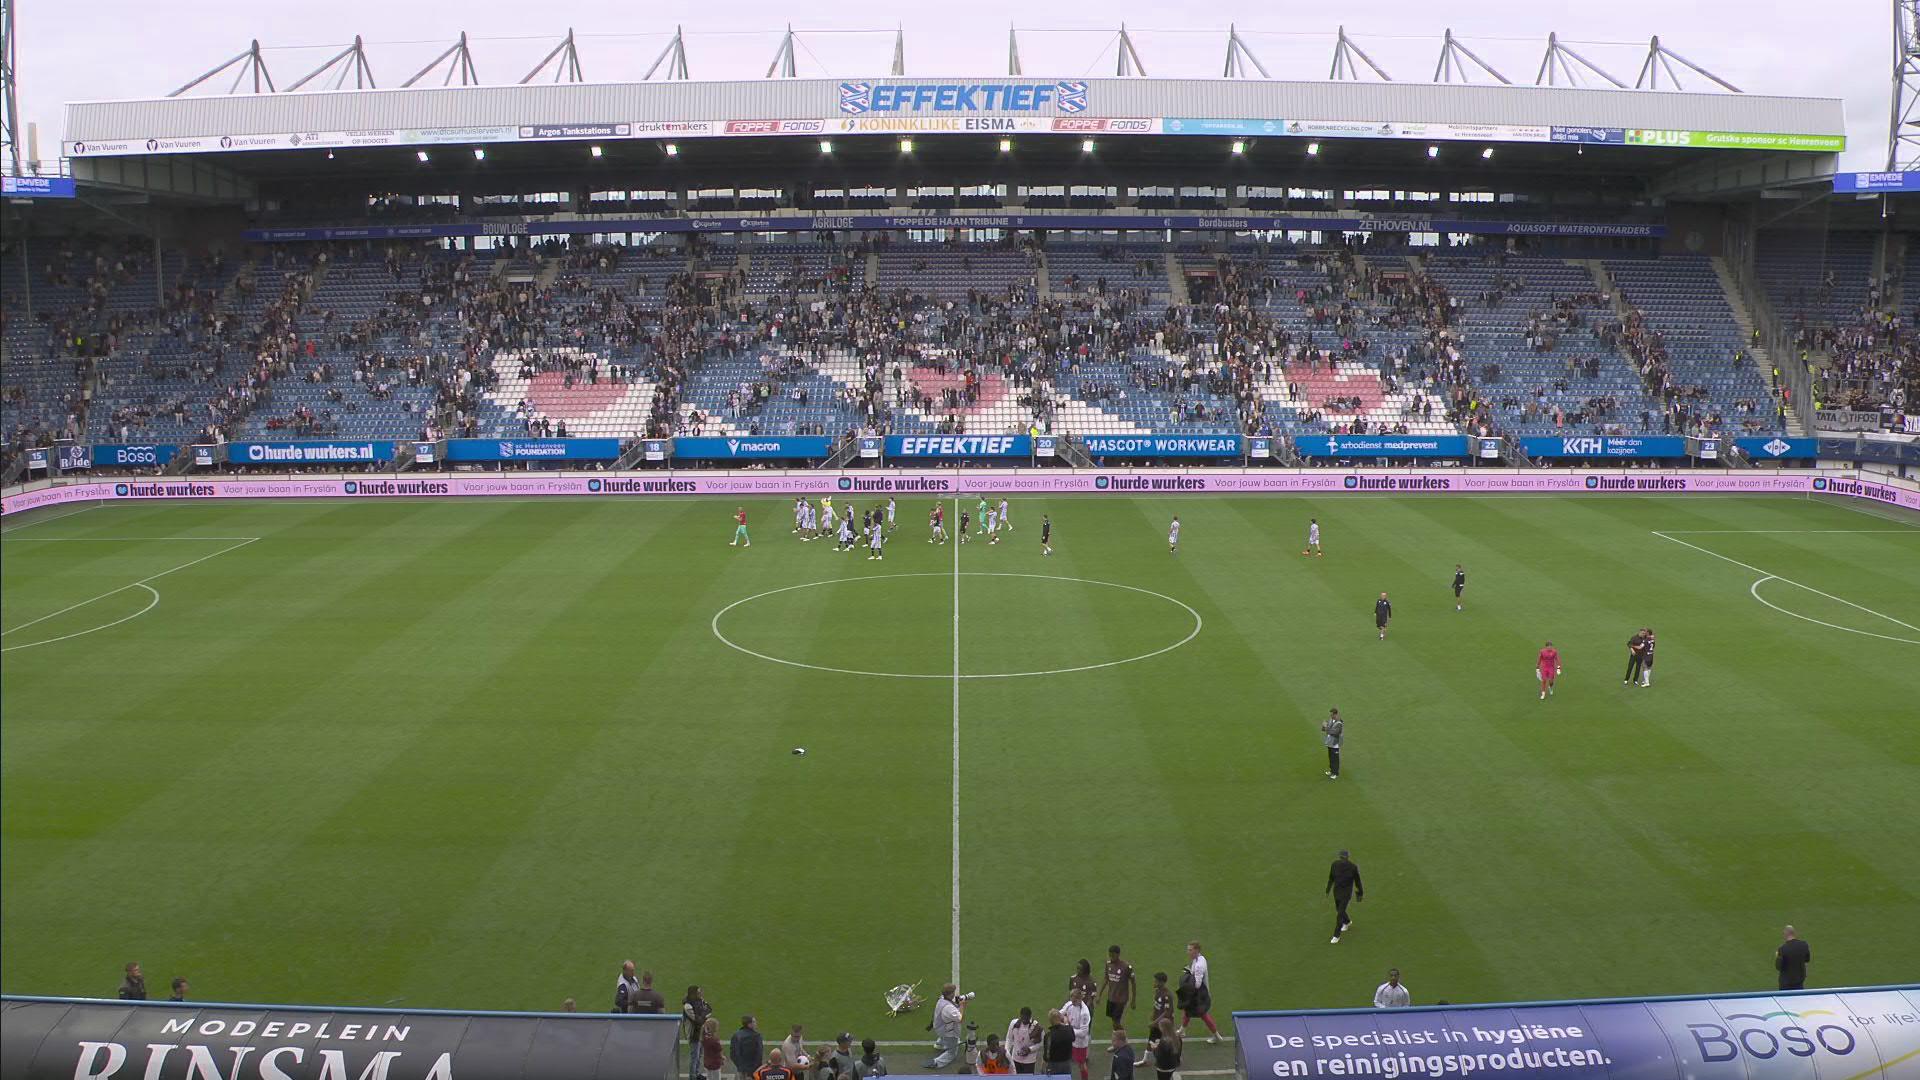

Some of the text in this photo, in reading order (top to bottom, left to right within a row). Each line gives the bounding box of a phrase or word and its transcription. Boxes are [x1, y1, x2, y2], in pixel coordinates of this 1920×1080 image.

[870, 84, 1056, 111] EFFEKTIEF
[638, 122, 708, 132] druktemakers
[733, 122, 820, 132] FOPPE FONDS
[859, 118, 1015, 131] KONINKLIJKE EISMA
[1060, 120, 1148, 130] FOPPE FONDS
[538, 126, 611, 137] Argos Tankstations
[233, 137, 276, 146] Van Vuuren
[1644, 131, 1690, 144] PLUS
[1706, 134, 1740, 144] Grutske
[1742, 136, 1776, 146] sponsor
[1788, 137, 1840, 147] Heerenveen
[86, 143, 128, 152] Van Vuuren
[160, 140, 201, 149] Van Vuuren
[812, 217, 854, 229] AGRILOGE
[894, 218, 924, 226] FOPPE
[925, 218, 937, 226] DE
[969, 217, 1009, 225] TRIBUNE
[1199, 218, 1248, 227] Bordbusters
[1359, 220, 1433, 230] ZETHOVEN.NL
[483, 224, 528, 234] BOUWLOGE
[1506, 224, 1651, 235] AQUASOFT WATERONTHARDERS
[1816, 412, 1837, 422] TATA
[1850, 412, 1878, 423] TIFOSI
[420, 445, 428, 453] 17
[649, 443, 659, 451] 18
[741, 442, 780, 451] macron
[901, 437, 1014, 454] EFFEKTIEF
[1155, 439, 1236, 451] WORKWEAR
[1341, 441, 1437, 451] arbodienst medprevent
[32, 452, 42, 460] 15
[265, 444, 373, 459] hurde wurkers.nl
[1607, 447, 1637, 455] kozijnen.
[359, 481, 448, 495] hurde wurkers
[463, 483, 484, 491] Voor
[486, 482, 508, 492] jouw
[510, 482, 534, 490] baan
[537, 481, 545, 490] in
[603, 478, 696, 492] hurde wurkers
[705, 481, 728, 489] Voor
[730, 480, 752, 490] jouw
[755, 480, 780, 489] baan
[783, 480, 792, 488] in
[854, 477, 948, 490] hurde wurkers
[965, 480, 988, 488] Voor
[990, 479, 1012, 490] jouw
[1015, 479, 1039, 488] baan
[1042, 479, 1050, 488] in
[1111, 476, 1205, 490] hurde wurkers
[1215, 479, 1237, 487] Voor
[1239, 479, 1260, 489] jouw
[1264, 478, 1287, 487] baan
[1290, 478, 1299, 487] in
[1359, 476, 1450, 489] hurde wurkers
[1465, 479, 1485, 487] Voor
[1487, 479, 1508, 489] jouw
[1511, 479, 1534, 487] baan
[1537, 479, 1545, 487] in
[1600, 476, 1686, 489] hurde wurkers
[1695, 480, 1714, 488] Voor
[1715, 479, 1735, 490] jouw
[1739, 479, 1761, 488] baan
[1763, 479, 1771, 488] in
[130, 483, 214, 497] hurde wurkers
[224, 485, 243, 494] Voor
[244, 485, 270, 495] jouw
[272, 484, 291, 493] baan
[293, 484, 301, 493] in
[1829, 479, 1896, 502] hurde wurkers
[12, 500, 26, 509] Voor
[27, 497, 40, 508] jouw
[41, 492, 62, 502] baan
[64, 490, 73, 499] in
[1904, 495, 1918, 505] Voor
[1848, 1015, 1875, 1028] for
[160, 1018, 411, 1041] MODEPLEIN
[1266, 1024, 1583, 1050] De specialist in hygiëne
[1272, 1048, 1612, 1078] en reinigingsproducten.
